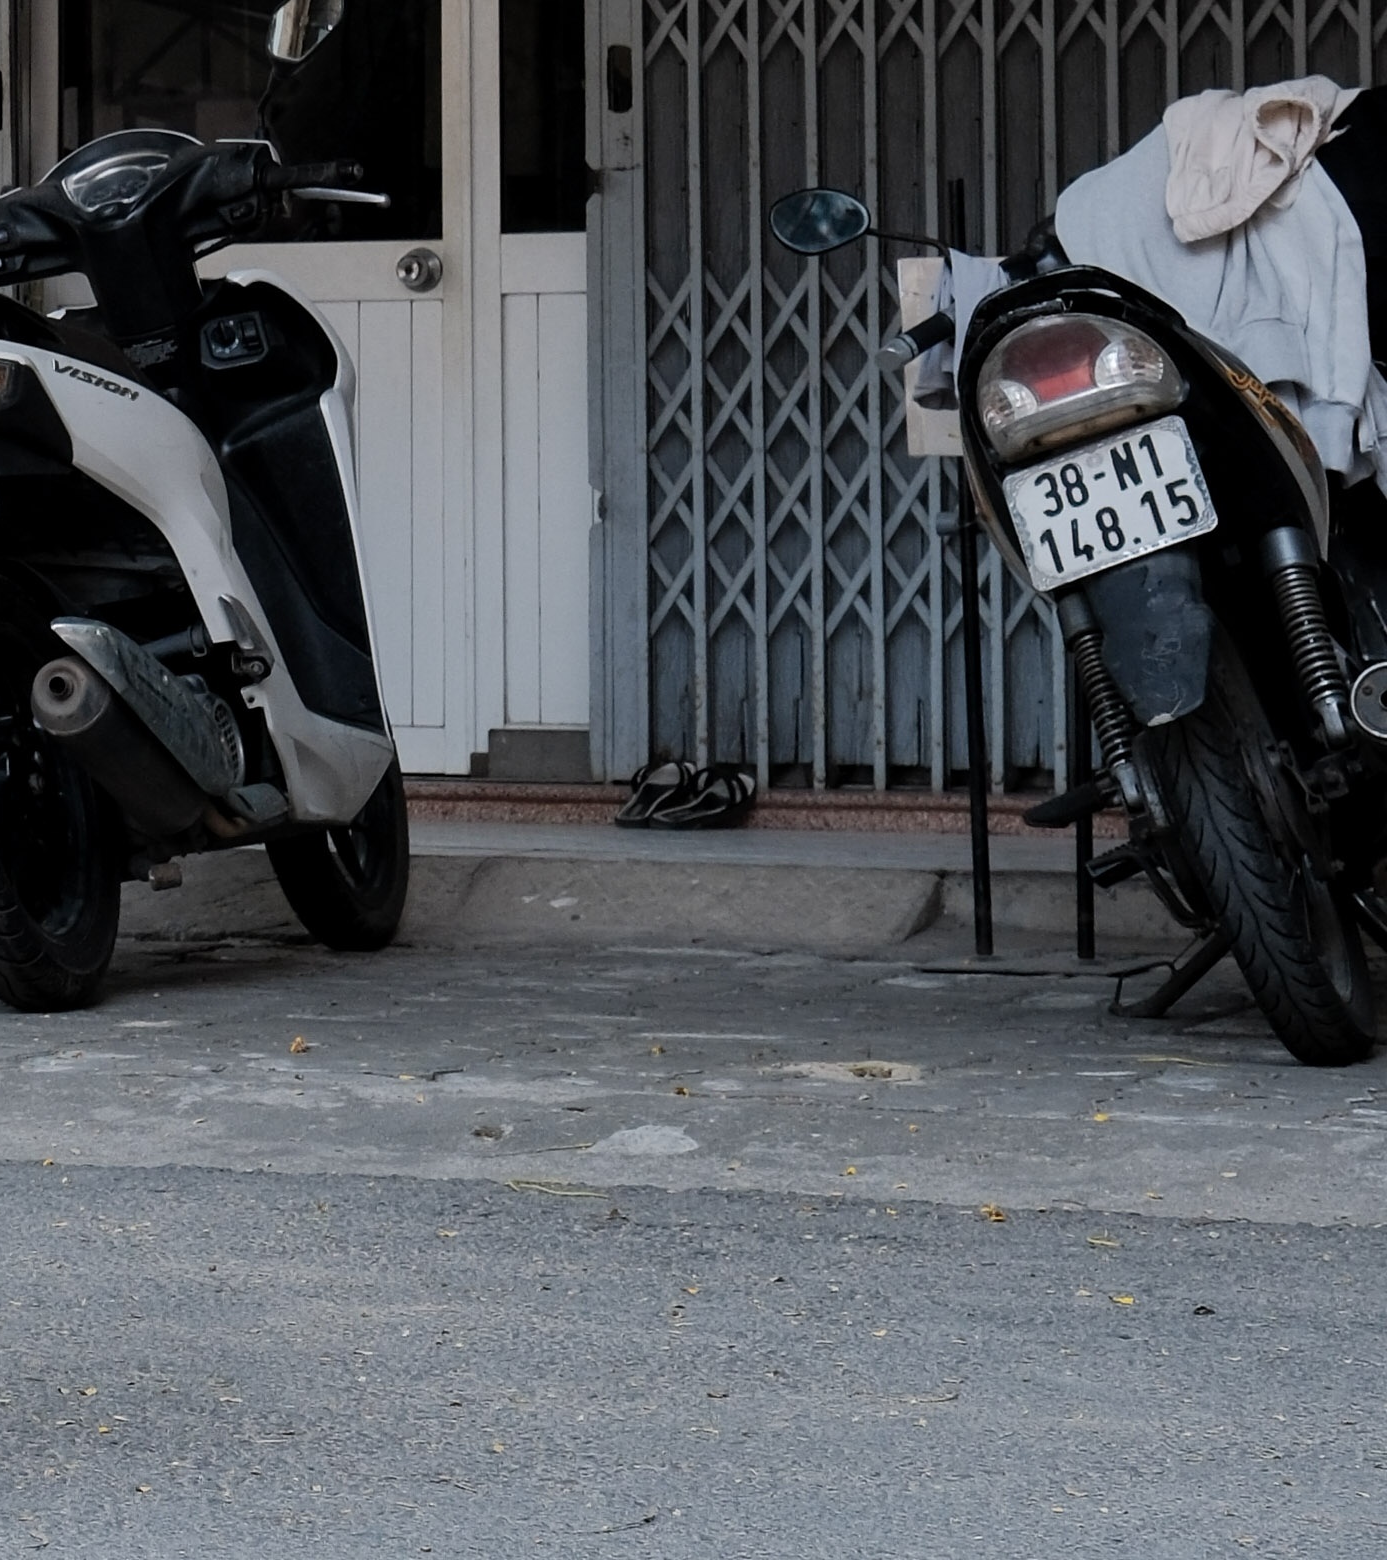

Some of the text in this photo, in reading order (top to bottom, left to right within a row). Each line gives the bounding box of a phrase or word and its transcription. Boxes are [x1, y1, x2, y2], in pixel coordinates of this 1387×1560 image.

[52, 358, 139, 402] VISION
[1034, 434, 1164, 518] 38-N1
[1039, 478, 1200, 574] 148.15
